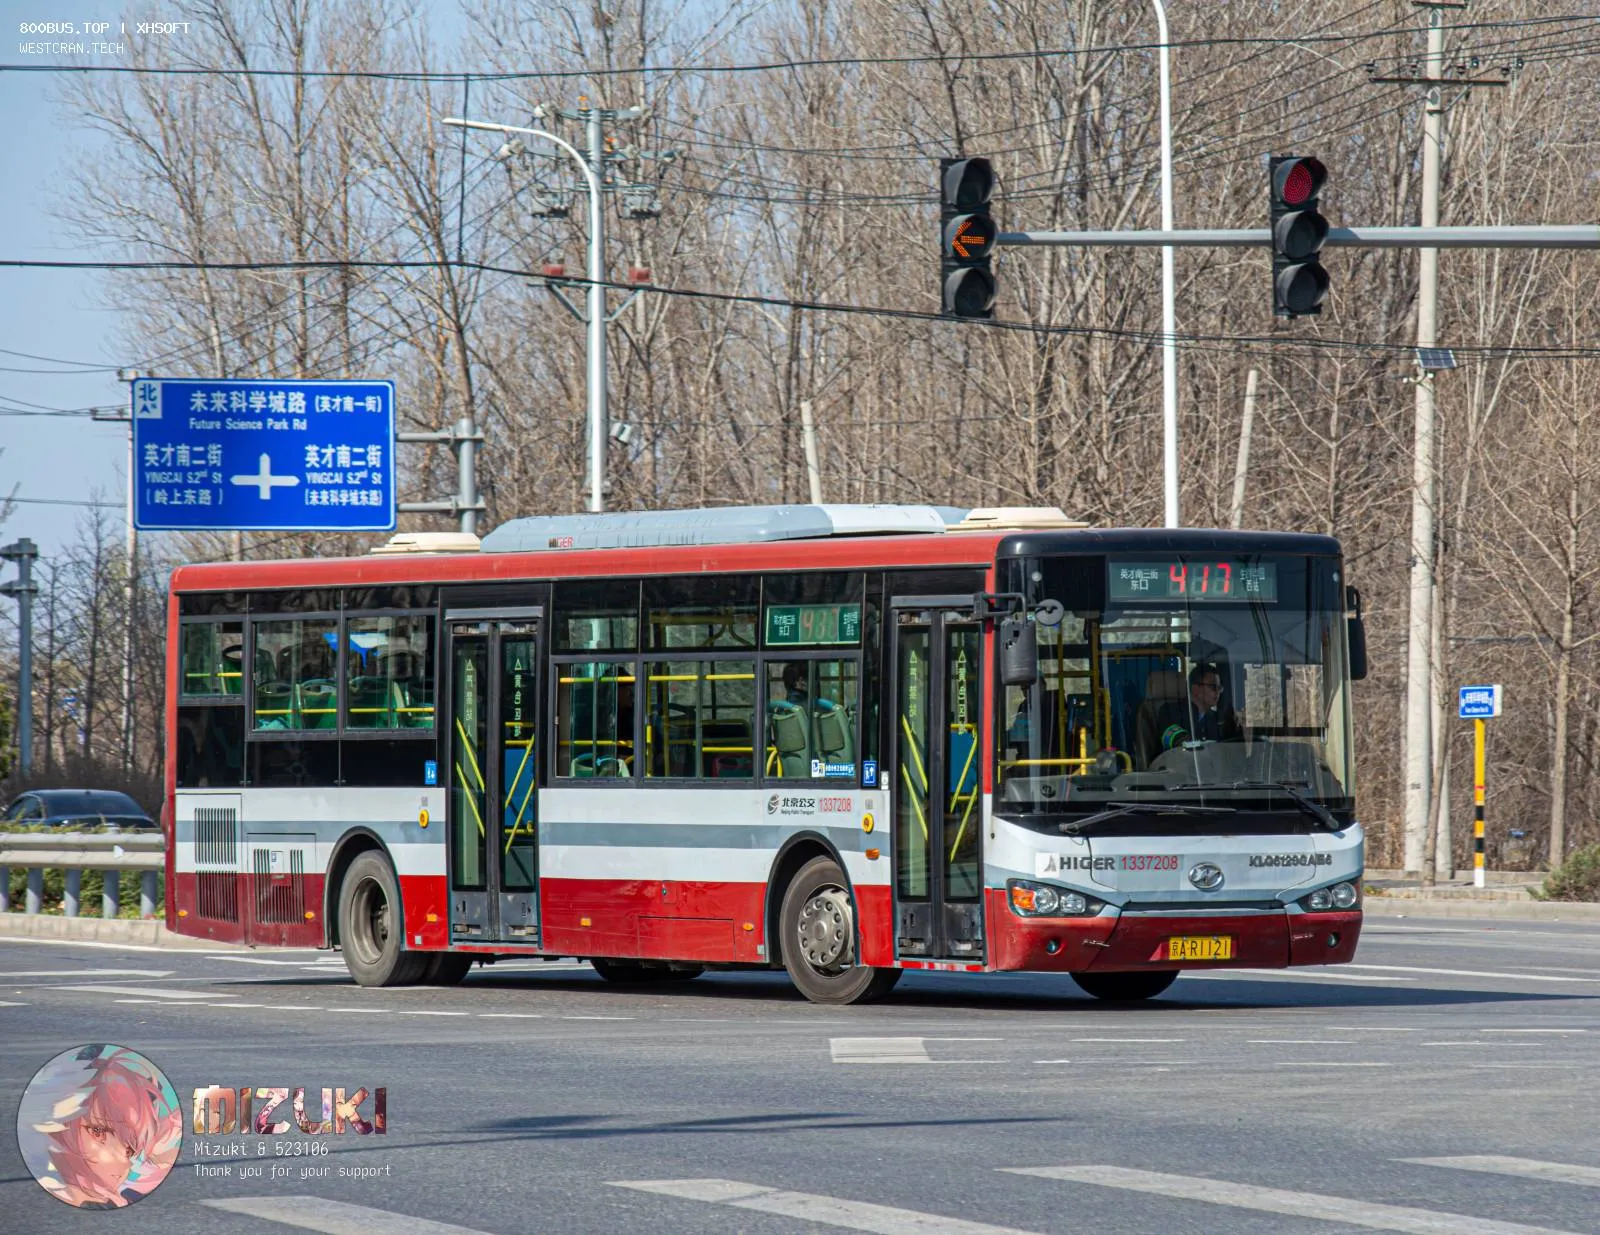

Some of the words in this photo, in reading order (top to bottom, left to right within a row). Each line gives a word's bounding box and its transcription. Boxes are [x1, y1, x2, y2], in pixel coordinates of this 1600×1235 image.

[139, 384, 157, 401] 北
[189, 390, 307, 414] 未来科学城路
[189, 418, 222, 430] Future
[226, 418, 263, 430] Science
[267, 419, 289, 430] Park
[293, 419, 307, 430] Rd
[144, 444, 223, 467] 英才南二街
[304, 444, 382, 468] 英才南二街
[144, 473, 183, 484] YINGCAI
[212, 473, 223, 484] St
[305, 473, 344, 485] YINGCAI
[371, 473, 382, 485] St
[1169, 563, 1232, 594] 417
[782, 797, 816, 808] 北京公交
[819, 797, 852, 812] 1337208
[1059, 856, 1116, 870] HIGER
[1120, 855, 1179, 870] 1337208
